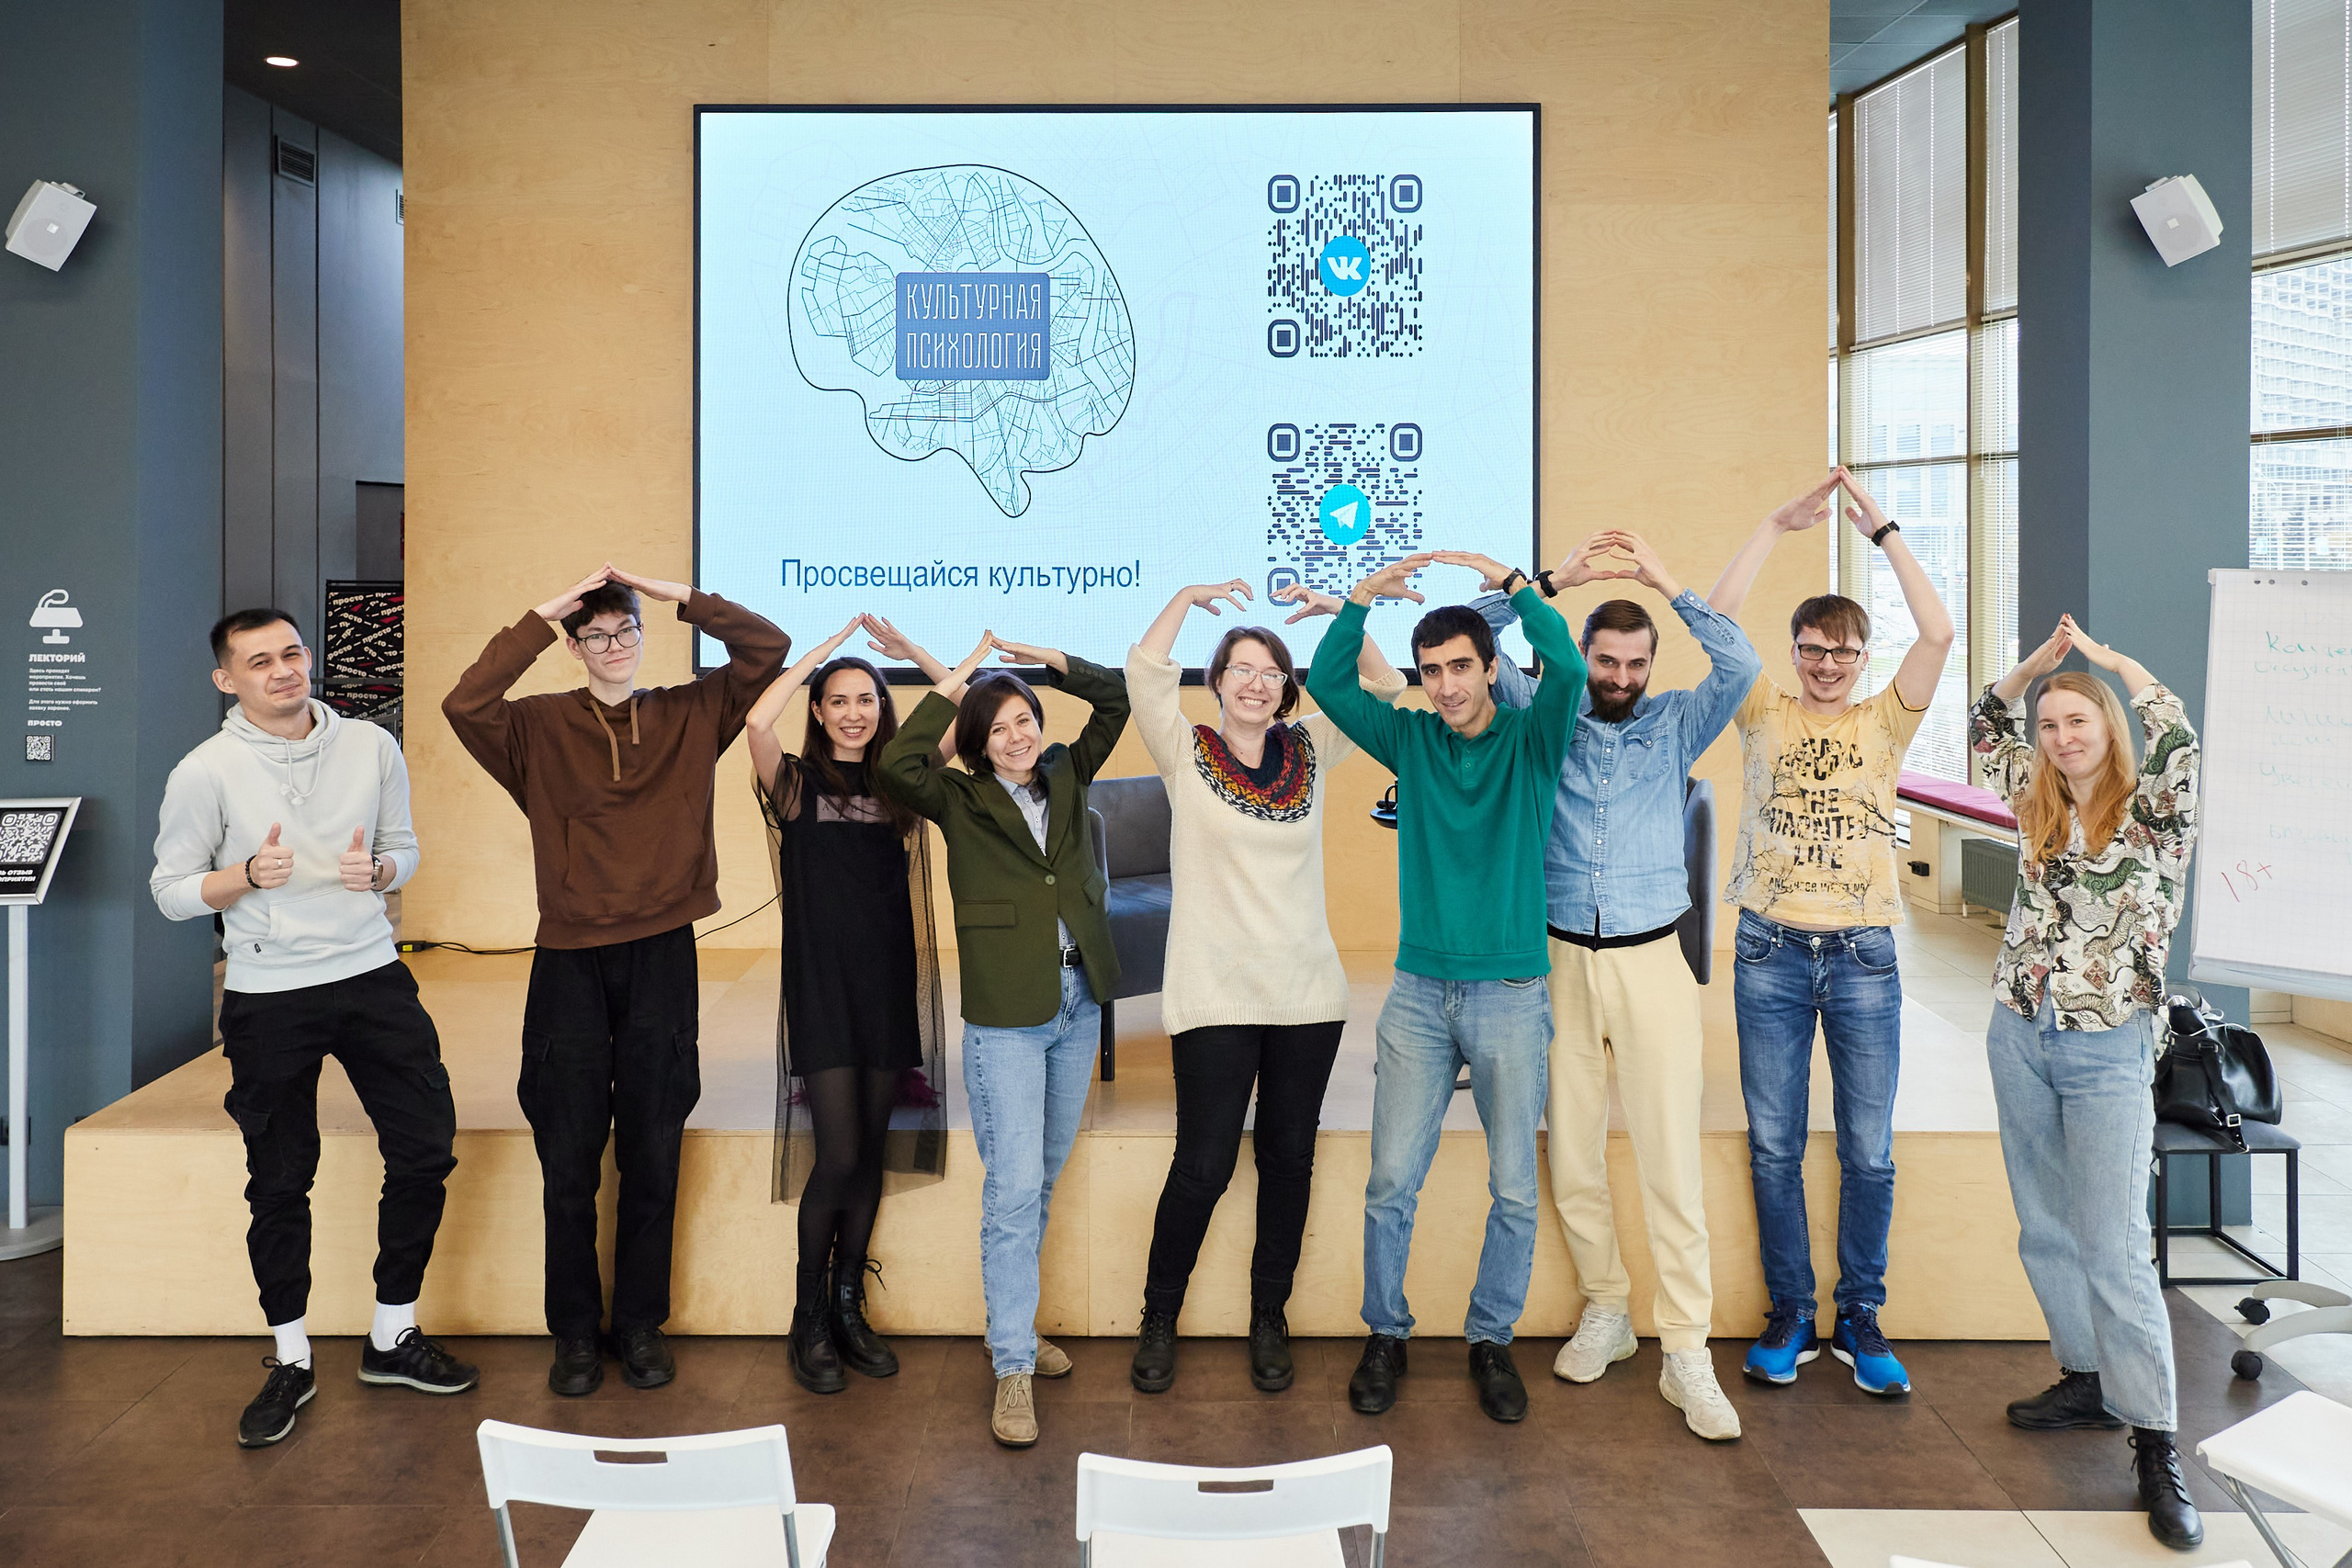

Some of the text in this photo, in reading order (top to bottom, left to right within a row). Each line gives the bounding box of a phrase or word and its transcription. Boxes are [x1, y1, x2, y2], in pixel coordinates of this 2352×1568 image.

[907, 283, 1041, 320] КУЛЬТУРНАЯ
[907, 333, 1041, 368] ПСИХОЛОГИЯ
[781, 558, 1140, 594] Просвещайся культурно!
[28, 652, 85, 663] ЛЕКТОРИЙ
[2221, 859, 2273, 903] 18+
